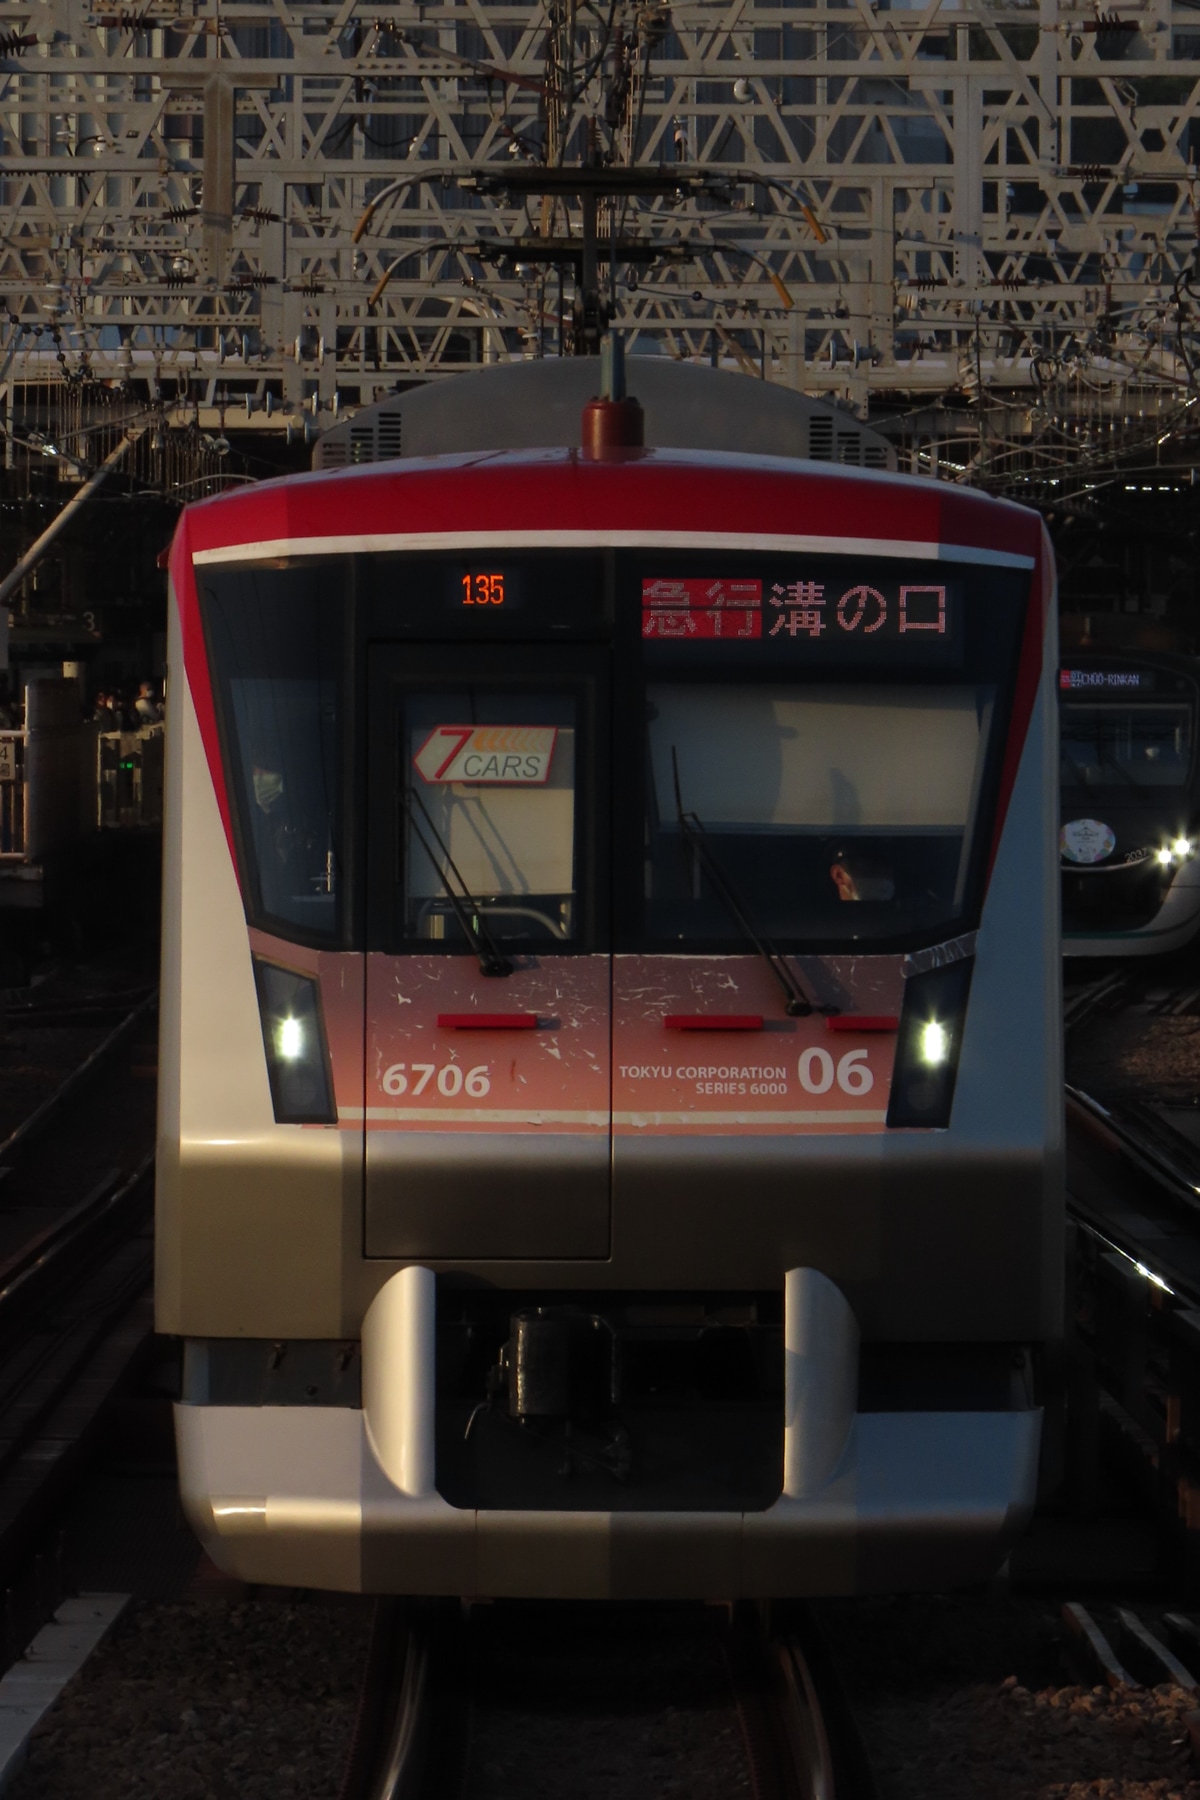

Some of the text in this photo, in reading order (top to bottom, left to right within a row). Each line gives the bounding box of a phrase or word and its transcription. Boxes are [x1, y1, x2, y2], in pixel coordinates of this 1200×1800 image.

[461, 573, 505, 605] 135
[83, 611, 96, 632] 3
[643, 580, 946, 637] 急行 溝の口
[439, 729, 541, 779] 7 CARS
[382, 1062, 491, 1098] 6706
[619, 1065, 787, 1080] TOKYU CORPORATION
[798, 1046, 875, 1096] 06
[695, 1082, 788, 1095] SERIES 6000
